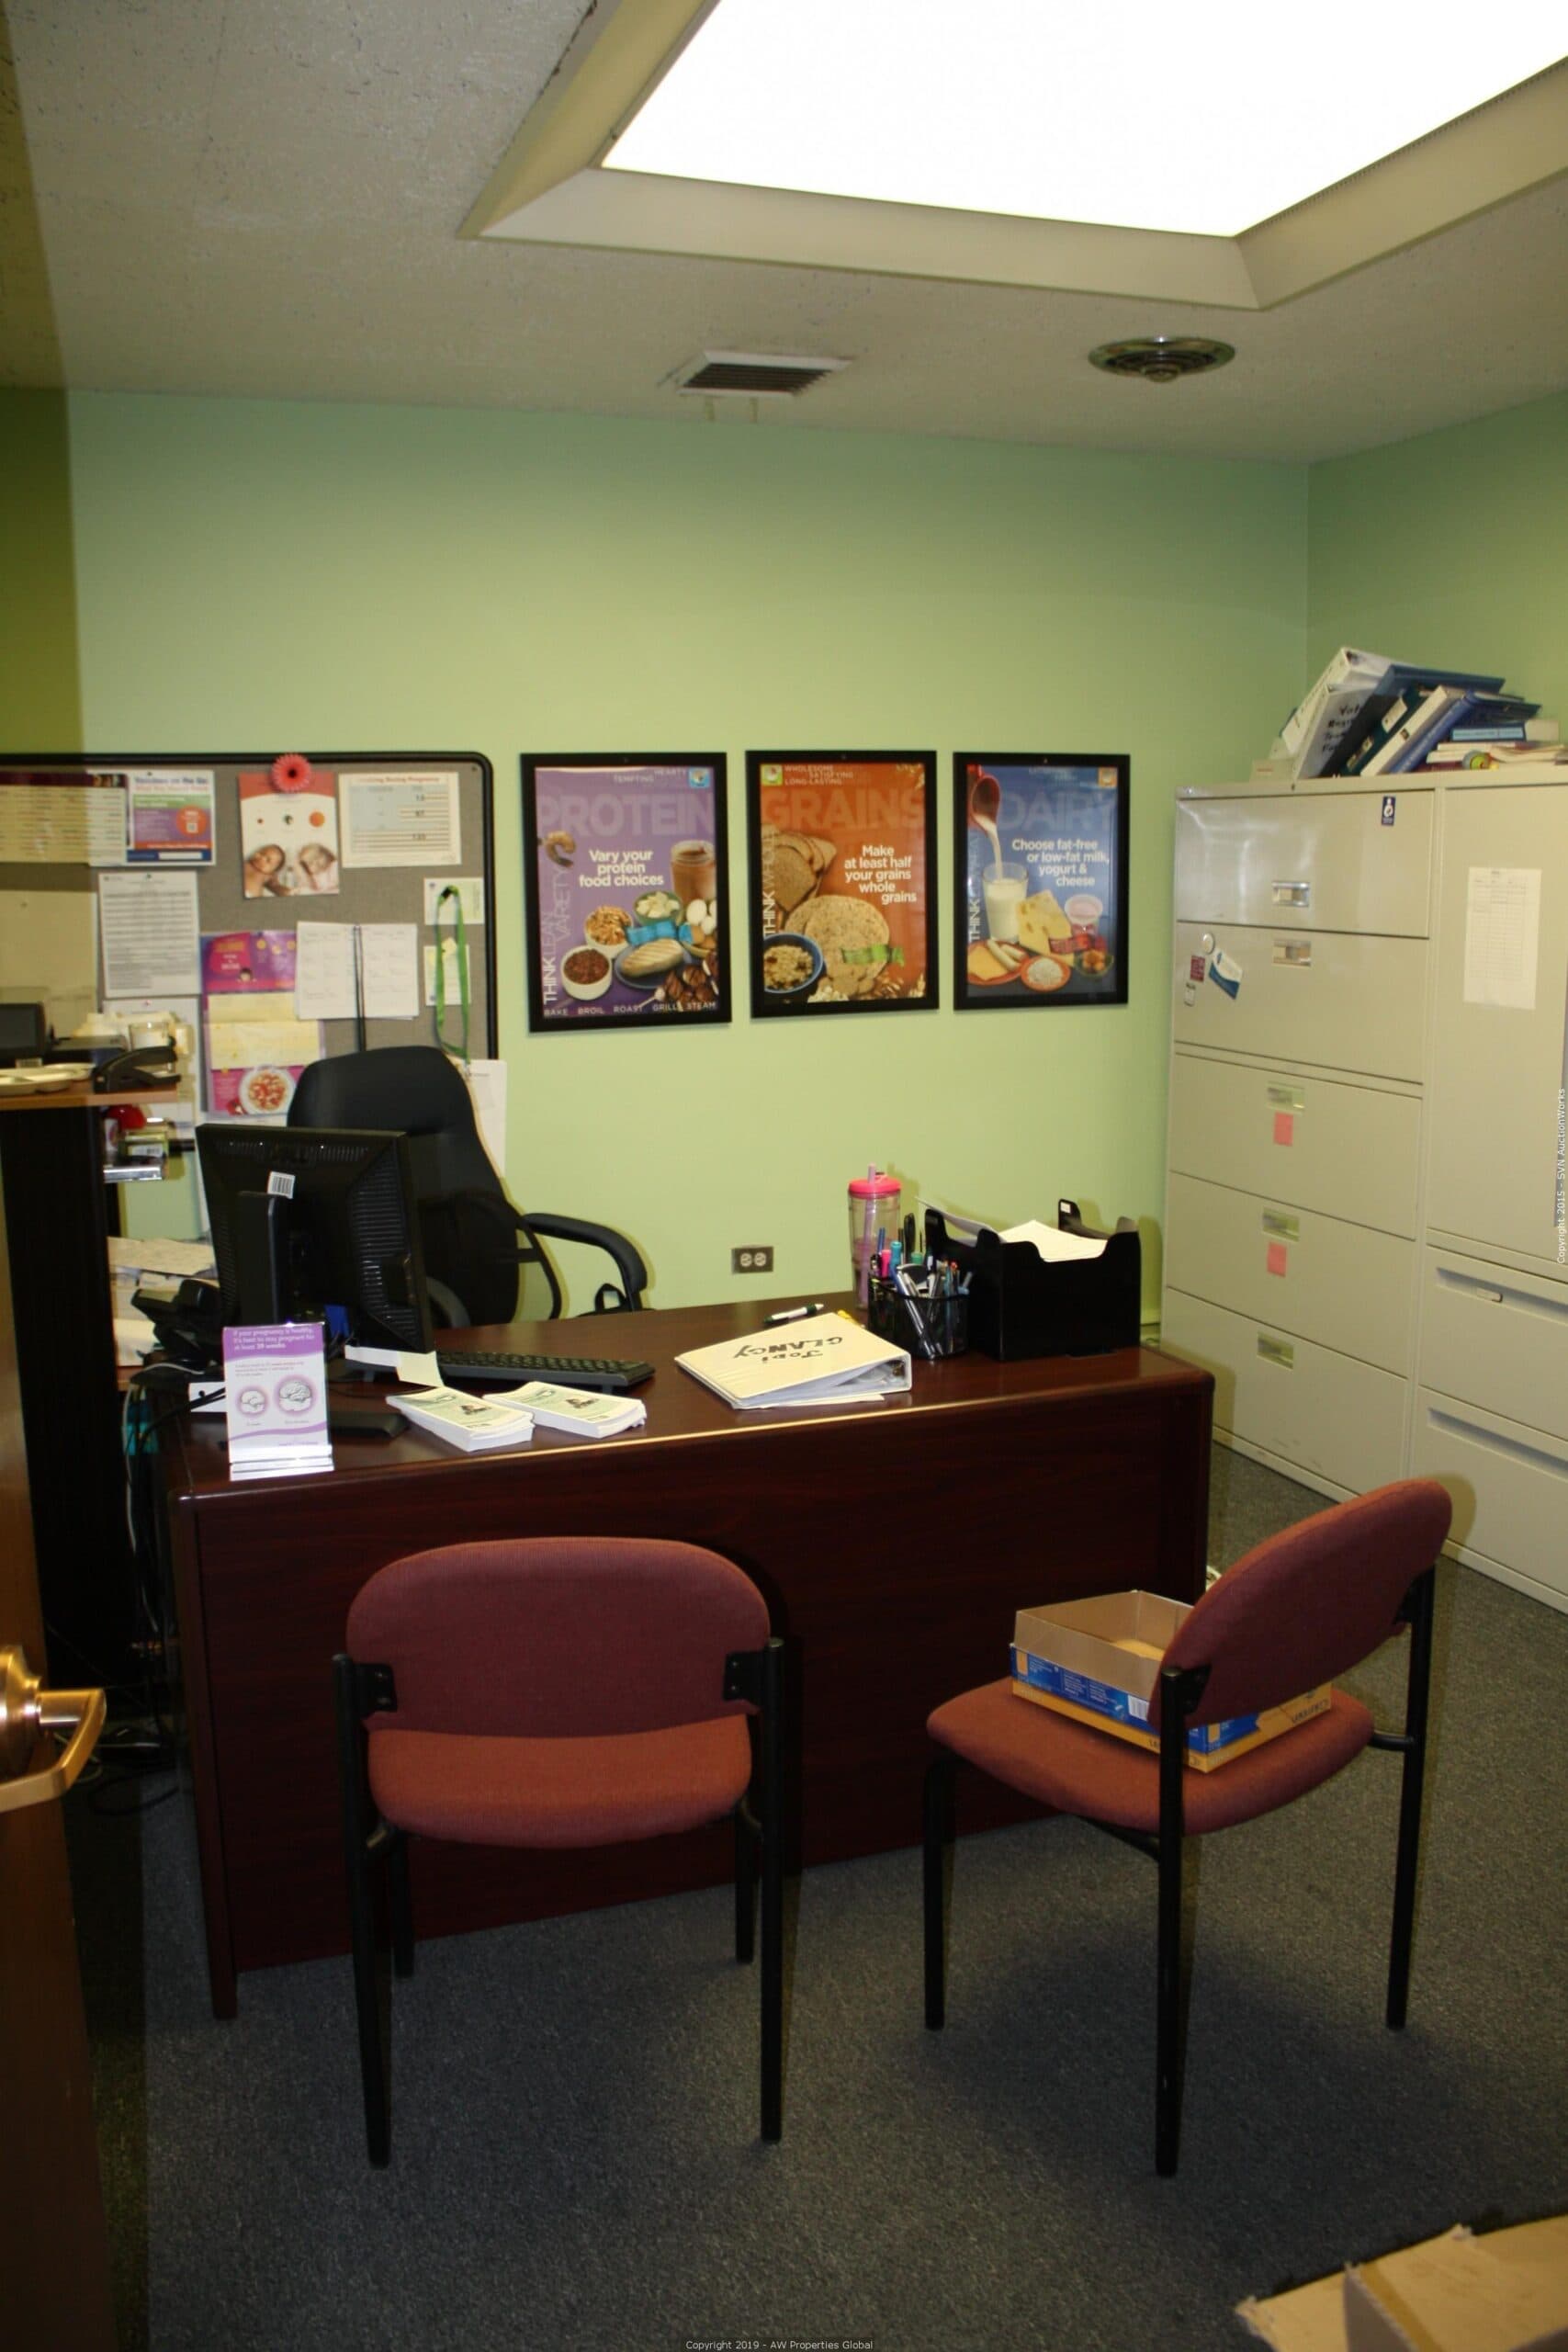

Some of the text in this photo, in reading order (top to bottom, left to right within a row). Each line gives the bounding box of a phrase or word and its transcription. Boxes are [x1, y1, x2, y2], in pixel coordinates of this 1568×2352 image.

[537, 793, 714, 837] PROTEIN
[762, 788, 925, 830] GRAINS
[1000, 790, 1117, 831] DAIRY
[862, 844, 895, 857] Make
[1012, 837, 1098, 851] Choose fat-free
[589, 849, 653, 864] Vary your
[844, 854, 912, 869] at least half
[1027, 854, 1039, 863] or
[1041, 852, 1080, 863] low-fat
[597, 861, 646, 876] protein
[845, 868, 912, 884] your grains
[1039, 864, 1088, 877] yogurt &
[579, 874, 665, 888] food choices
[859, 881, 897, 894] whole
[1056, 876, 1096, 887] cheese
[881, 891, 918, 906] grains
[763, 890, 776, 936] THINK
[968, 899, 981, 943] THINK
[543, 956, 558, 1004] THINK
[544, 1008, 568, 1016] BAKE
[578, 1006, 604, 1015] BROIL
[614, 1004, 643, 1014] ROAST
[687, 1001, 716, 1012] STEAM
